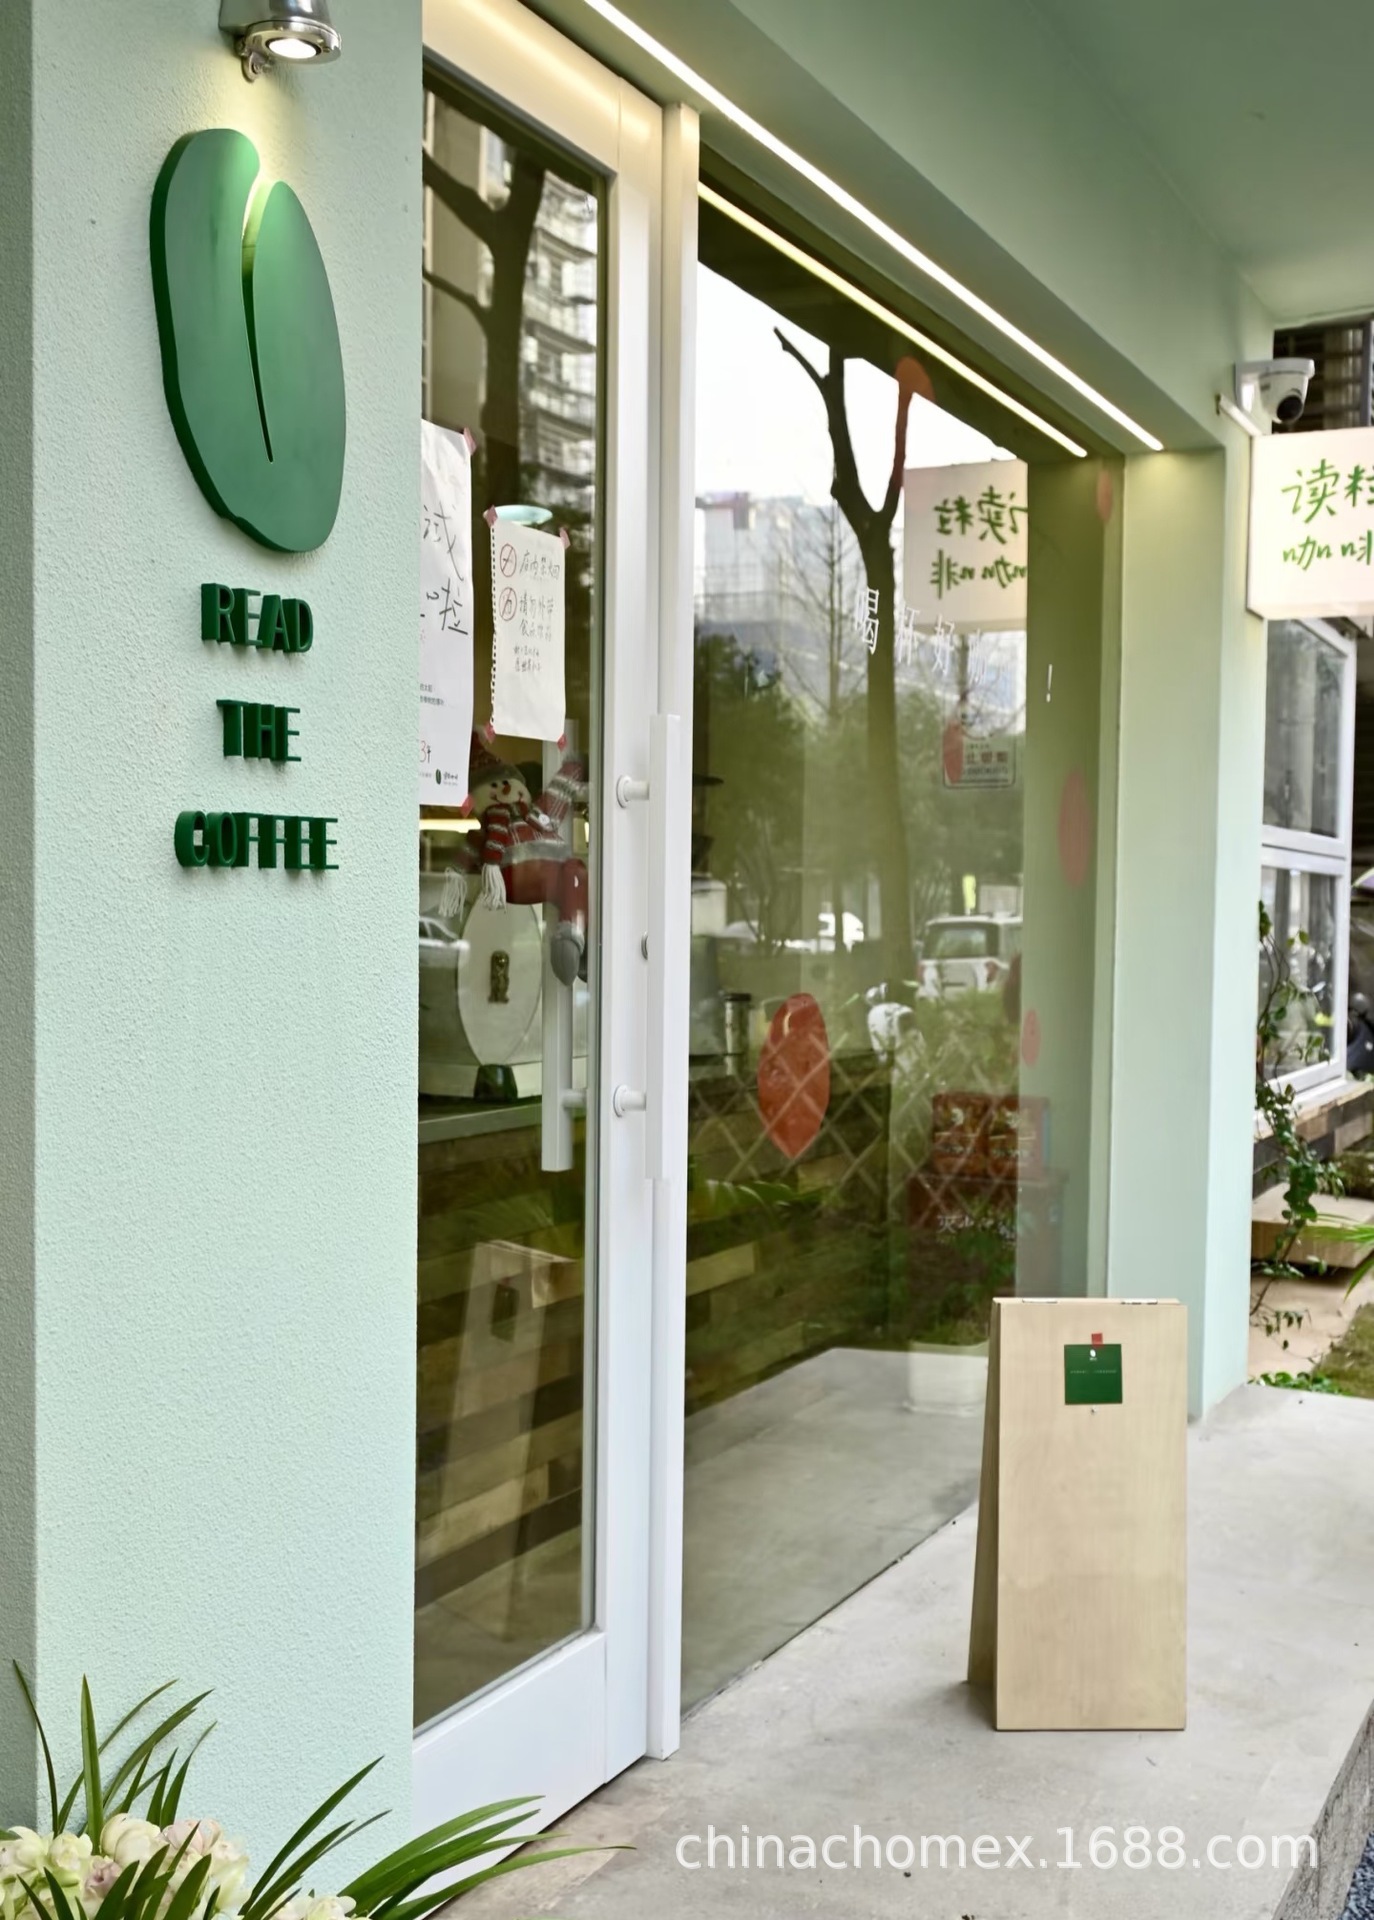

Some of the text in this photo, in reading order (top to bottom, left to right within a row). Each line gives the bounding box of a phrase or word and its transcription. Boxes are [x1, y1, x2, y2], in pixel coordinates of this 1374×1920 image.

[200, 582, 314, 653] READ
[420, 577, 469, 635] 啦
[215, 699, 302, 762] THE
[174, 810, 340, 871] COFFEE
